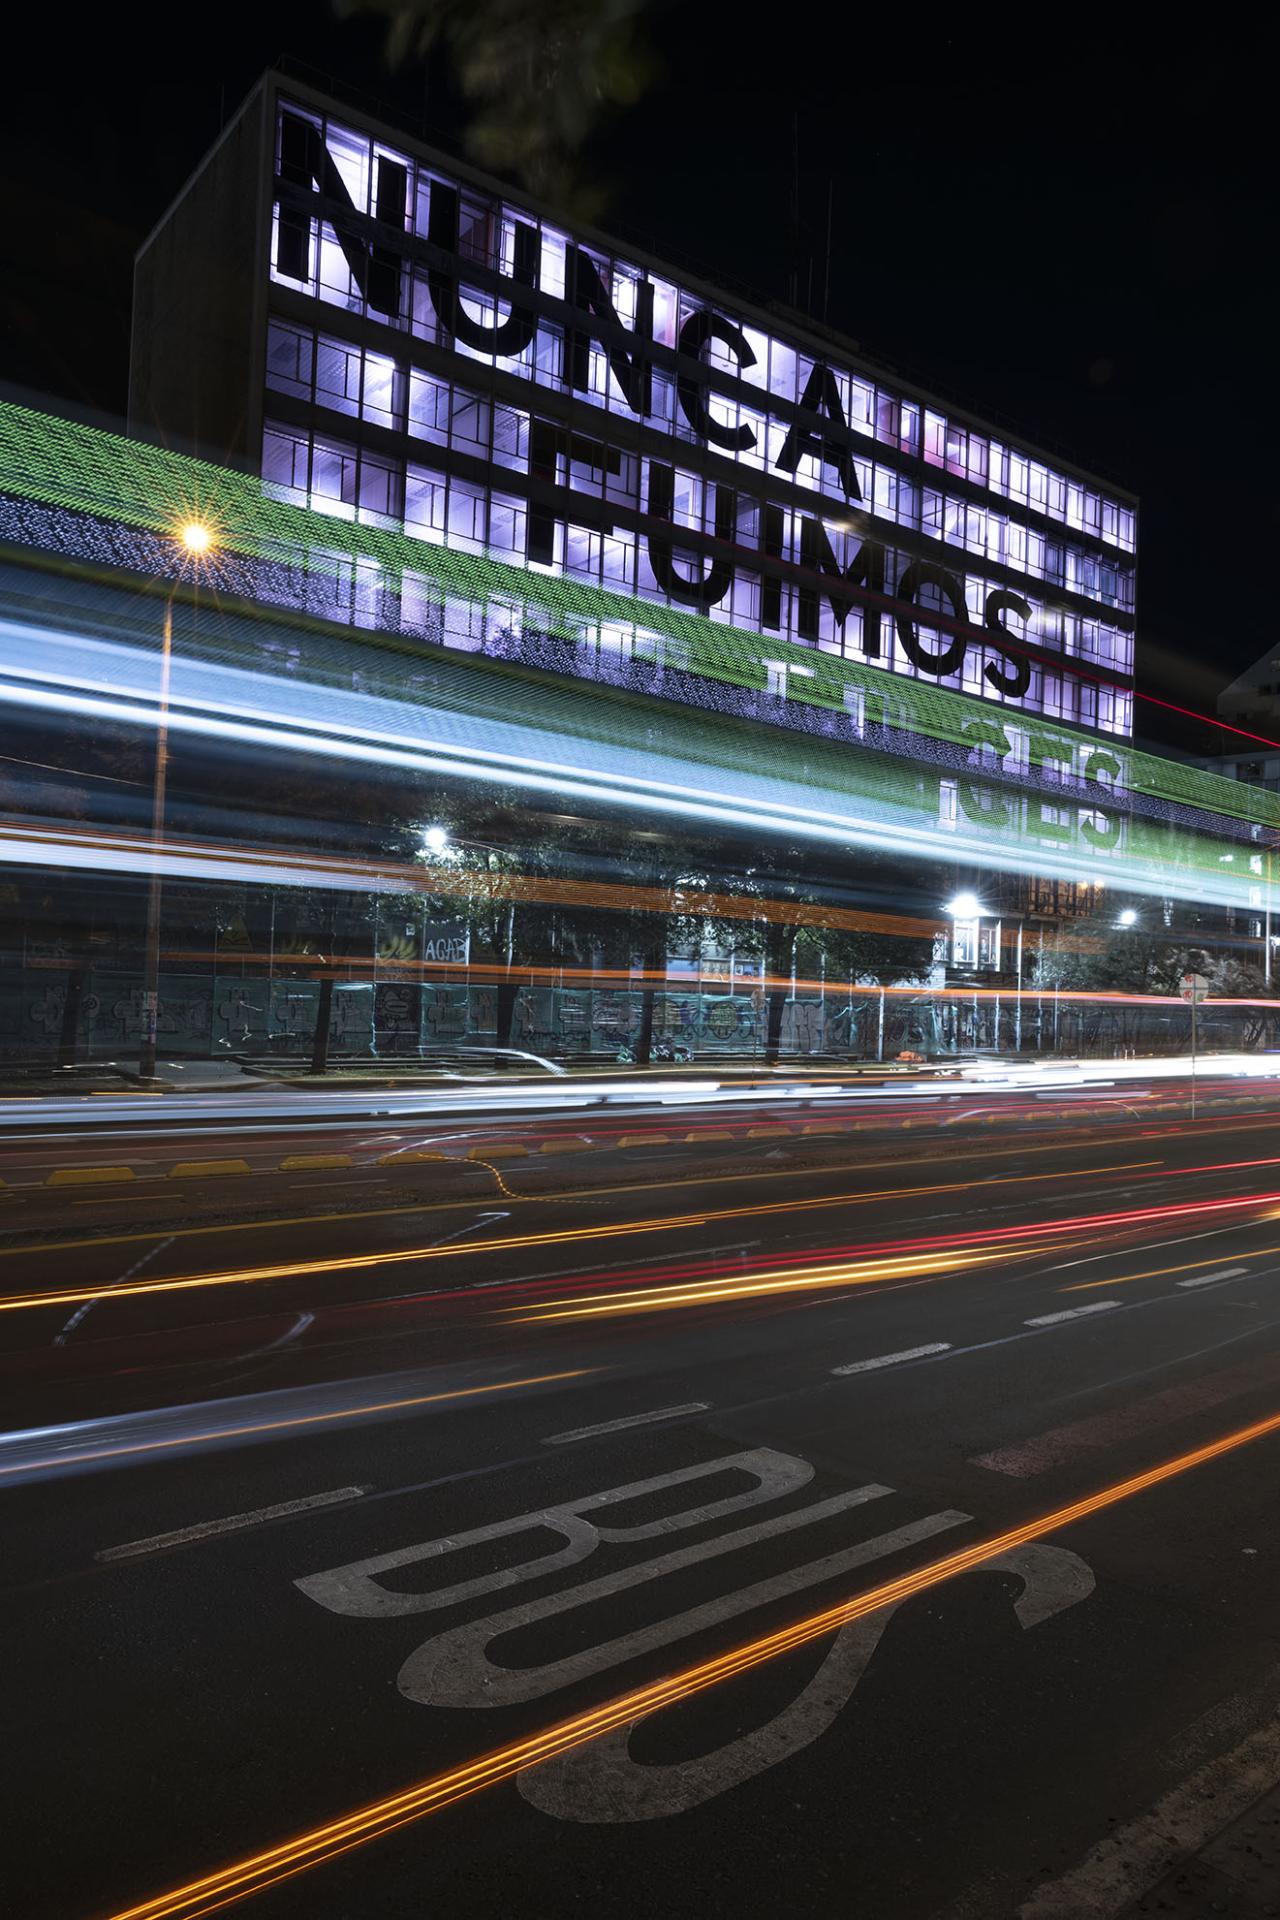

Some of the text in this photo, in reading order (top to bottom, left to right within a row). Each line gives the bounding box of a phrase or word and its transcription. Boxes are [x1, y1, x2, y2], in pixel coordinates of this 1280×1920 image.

[276, 110, 862, 501] NUNCA
[528, 410, 1033, 698] FUIMOS
[293, 1446, 1096, 1826] BUS
